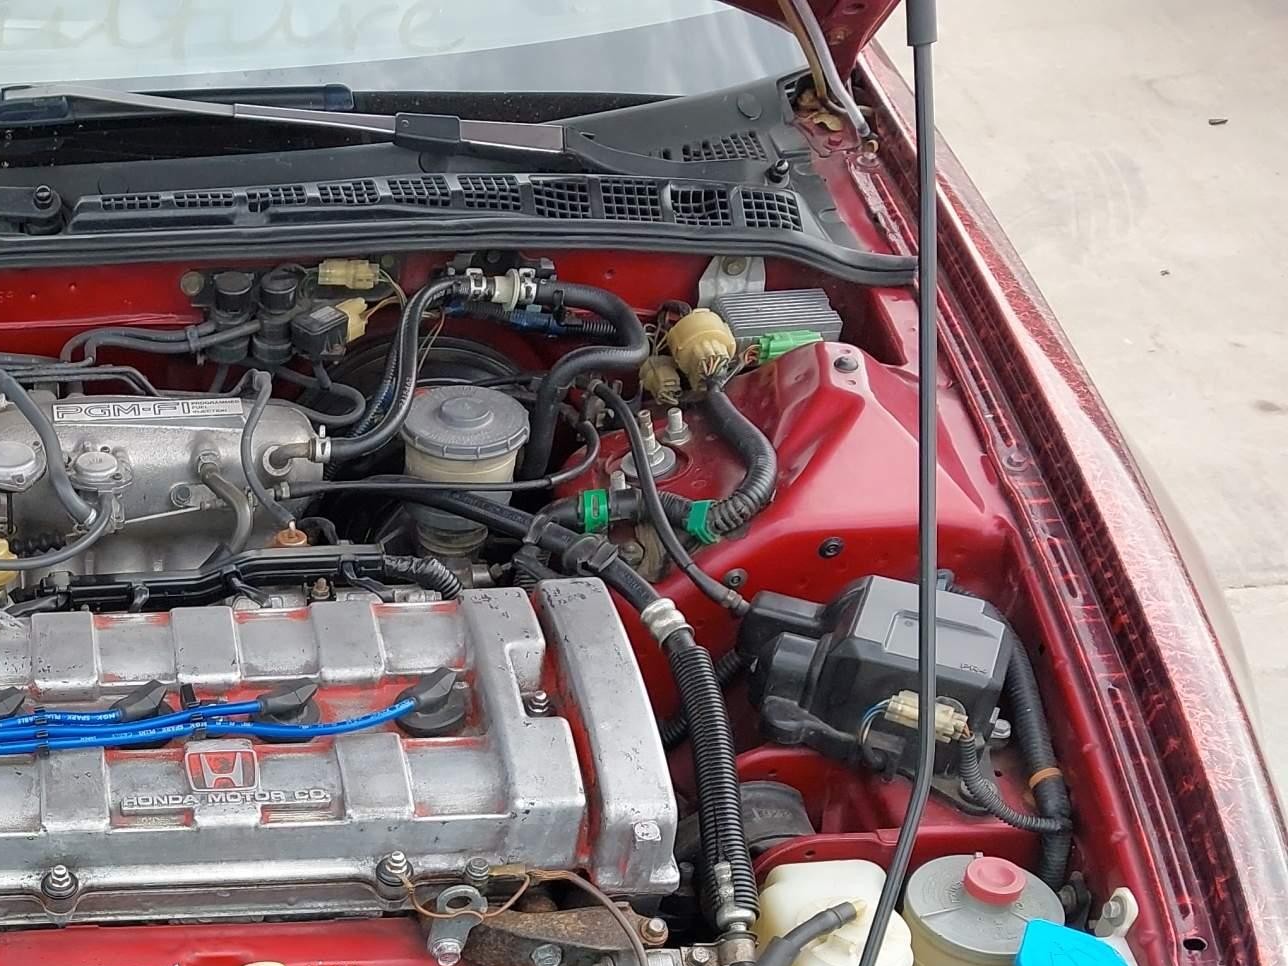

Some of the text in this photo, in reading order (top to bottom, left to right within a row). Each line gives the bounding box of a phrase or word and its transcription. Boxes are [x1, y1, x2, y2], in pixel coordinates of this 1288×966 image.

[56, 401, 190, 419] PGM-FI
[123, 789, 330, 807] HONDA MOTOR CO.
